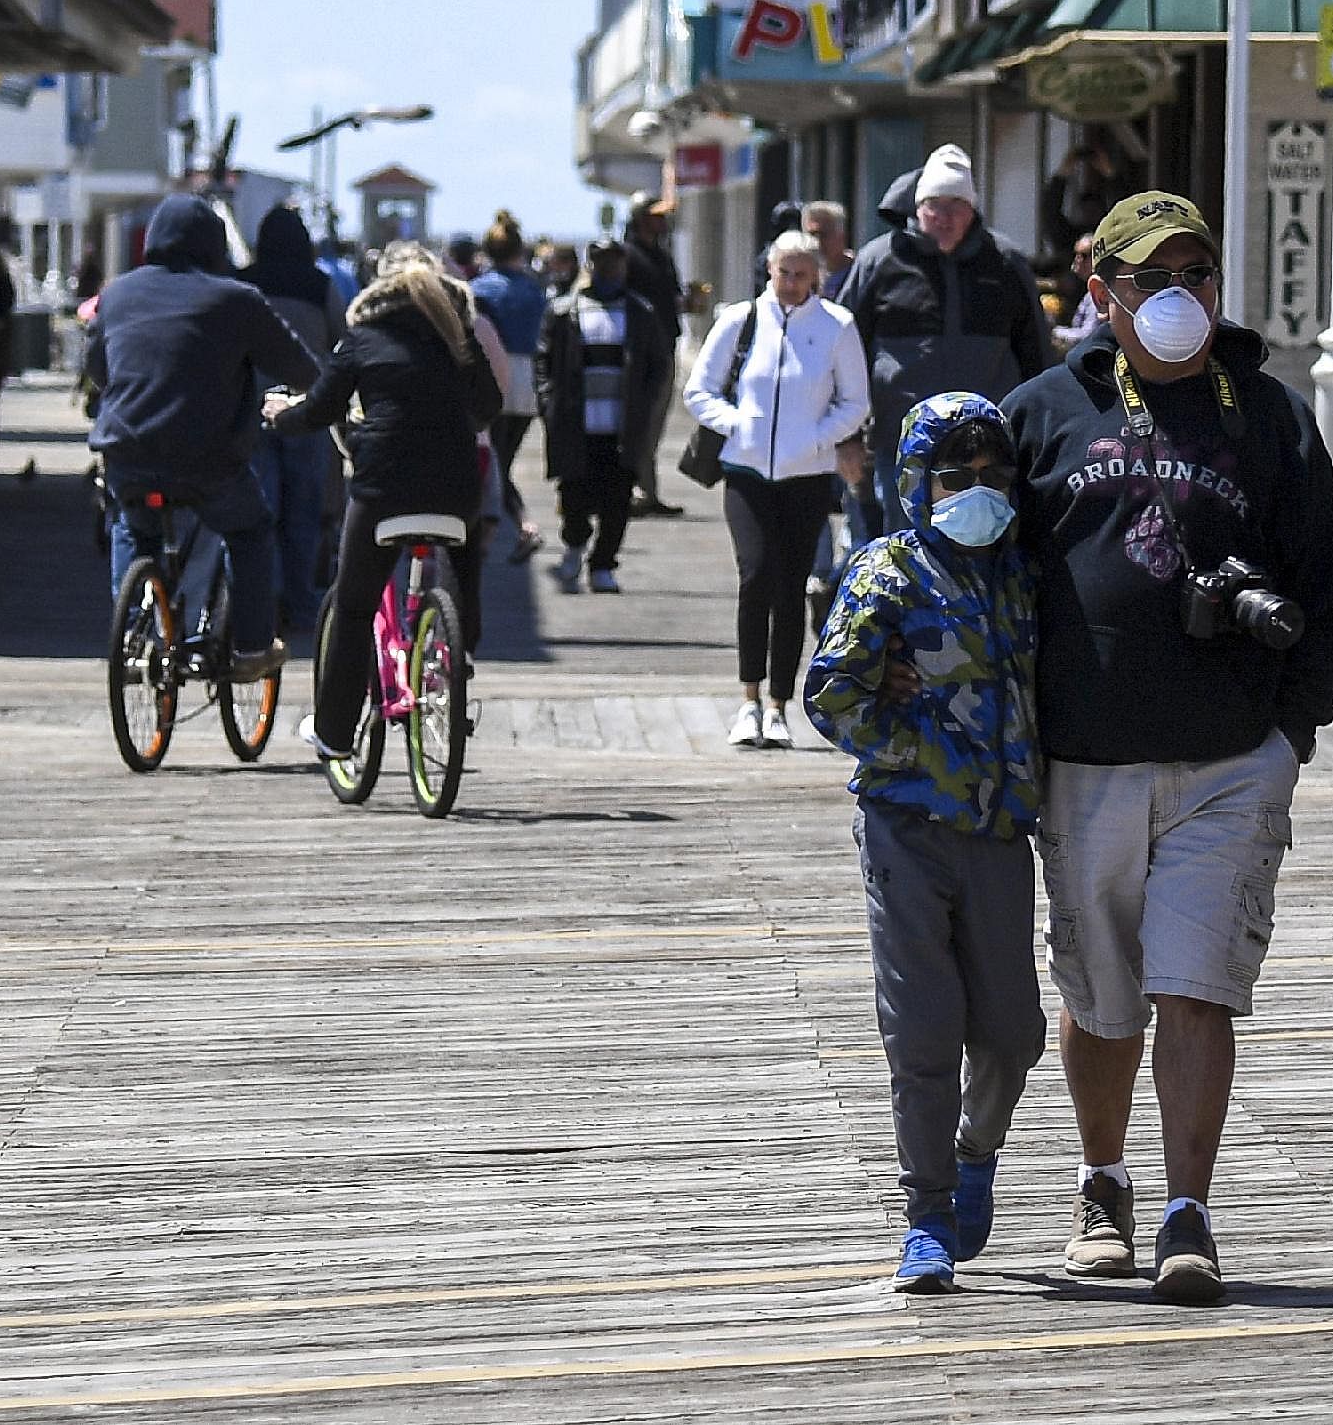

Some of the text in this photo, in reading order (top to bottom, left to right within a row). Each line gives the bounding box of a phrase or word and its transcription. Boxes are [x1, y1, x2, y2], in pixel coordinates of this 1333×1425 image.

[1281, 187, 1310, 337] TAFFY
[1122, 375, 1141, 408] Nikon
[1218, 373, 1234, 408] Nikon
[1068, 458, 1248, 519] BROADNECK
